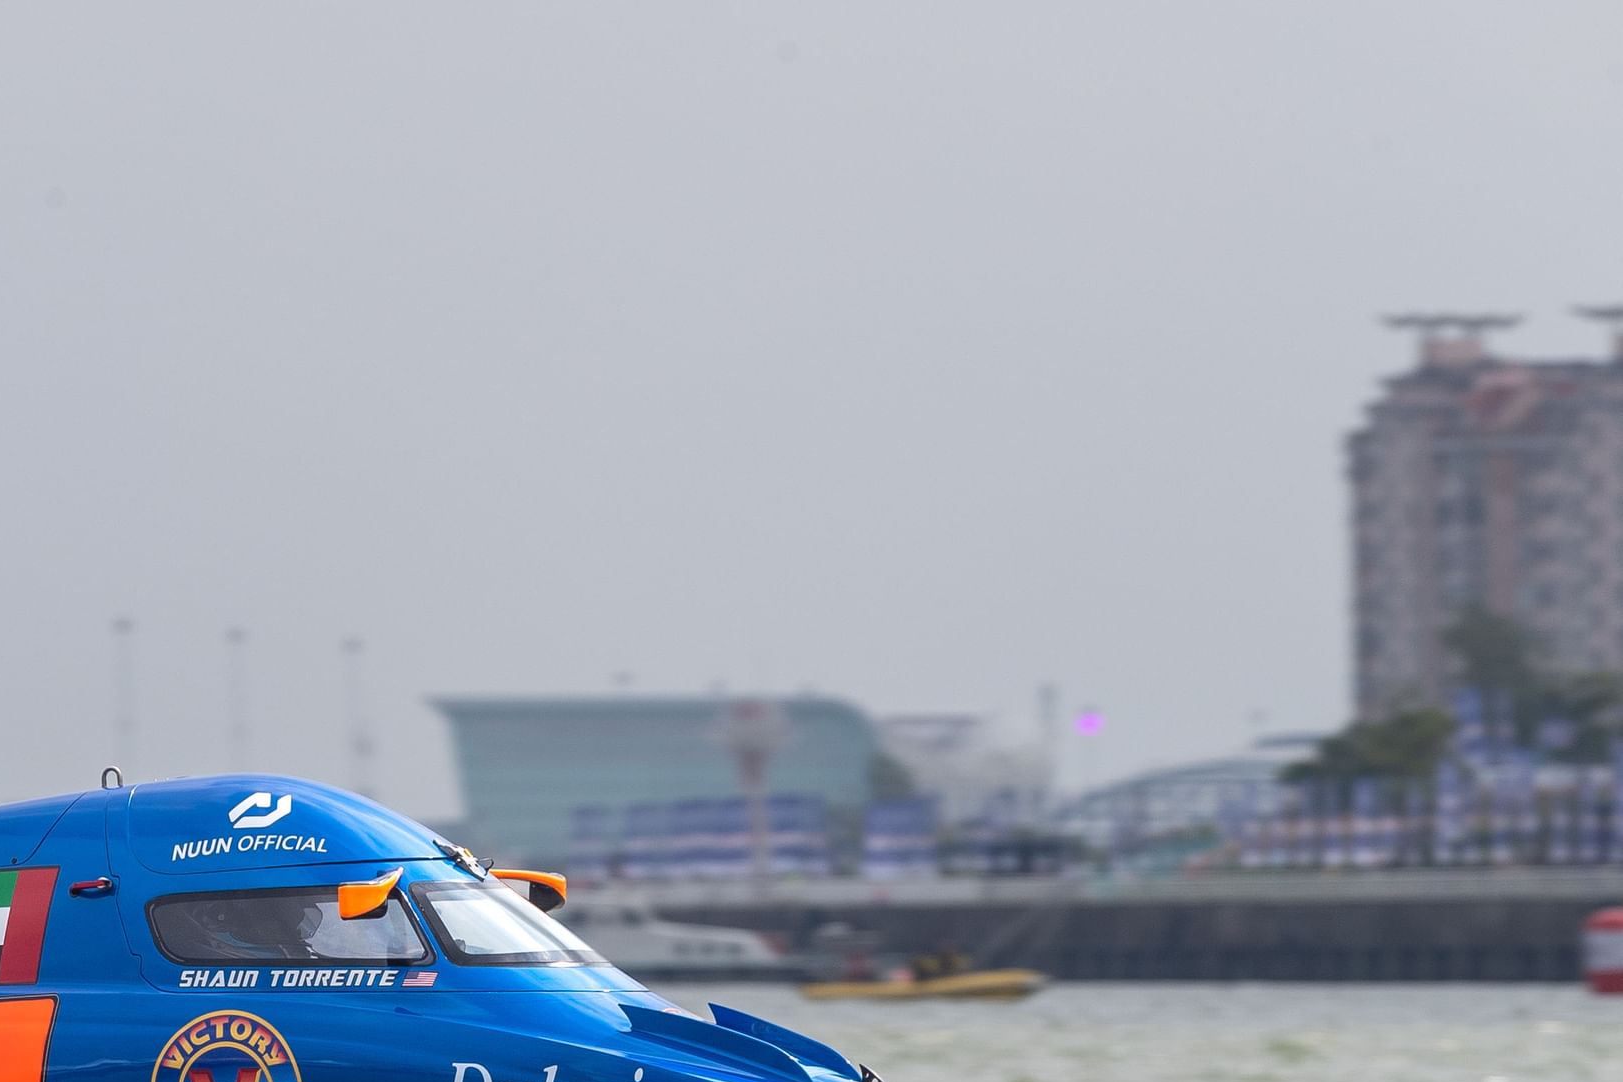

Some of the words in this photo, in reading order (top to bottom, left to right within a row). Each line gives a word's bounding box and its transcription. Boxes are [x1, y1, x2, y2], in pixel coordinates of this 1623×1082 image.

[172, 837, 232, 861] NUUN
[238, 834, 328, 853] OFFICIAL
[179, 969, 259, 988] SHAUN
[270, 969, 400, 987] TORRENTE
[161, 1015, 287, 1070] VICTORY
